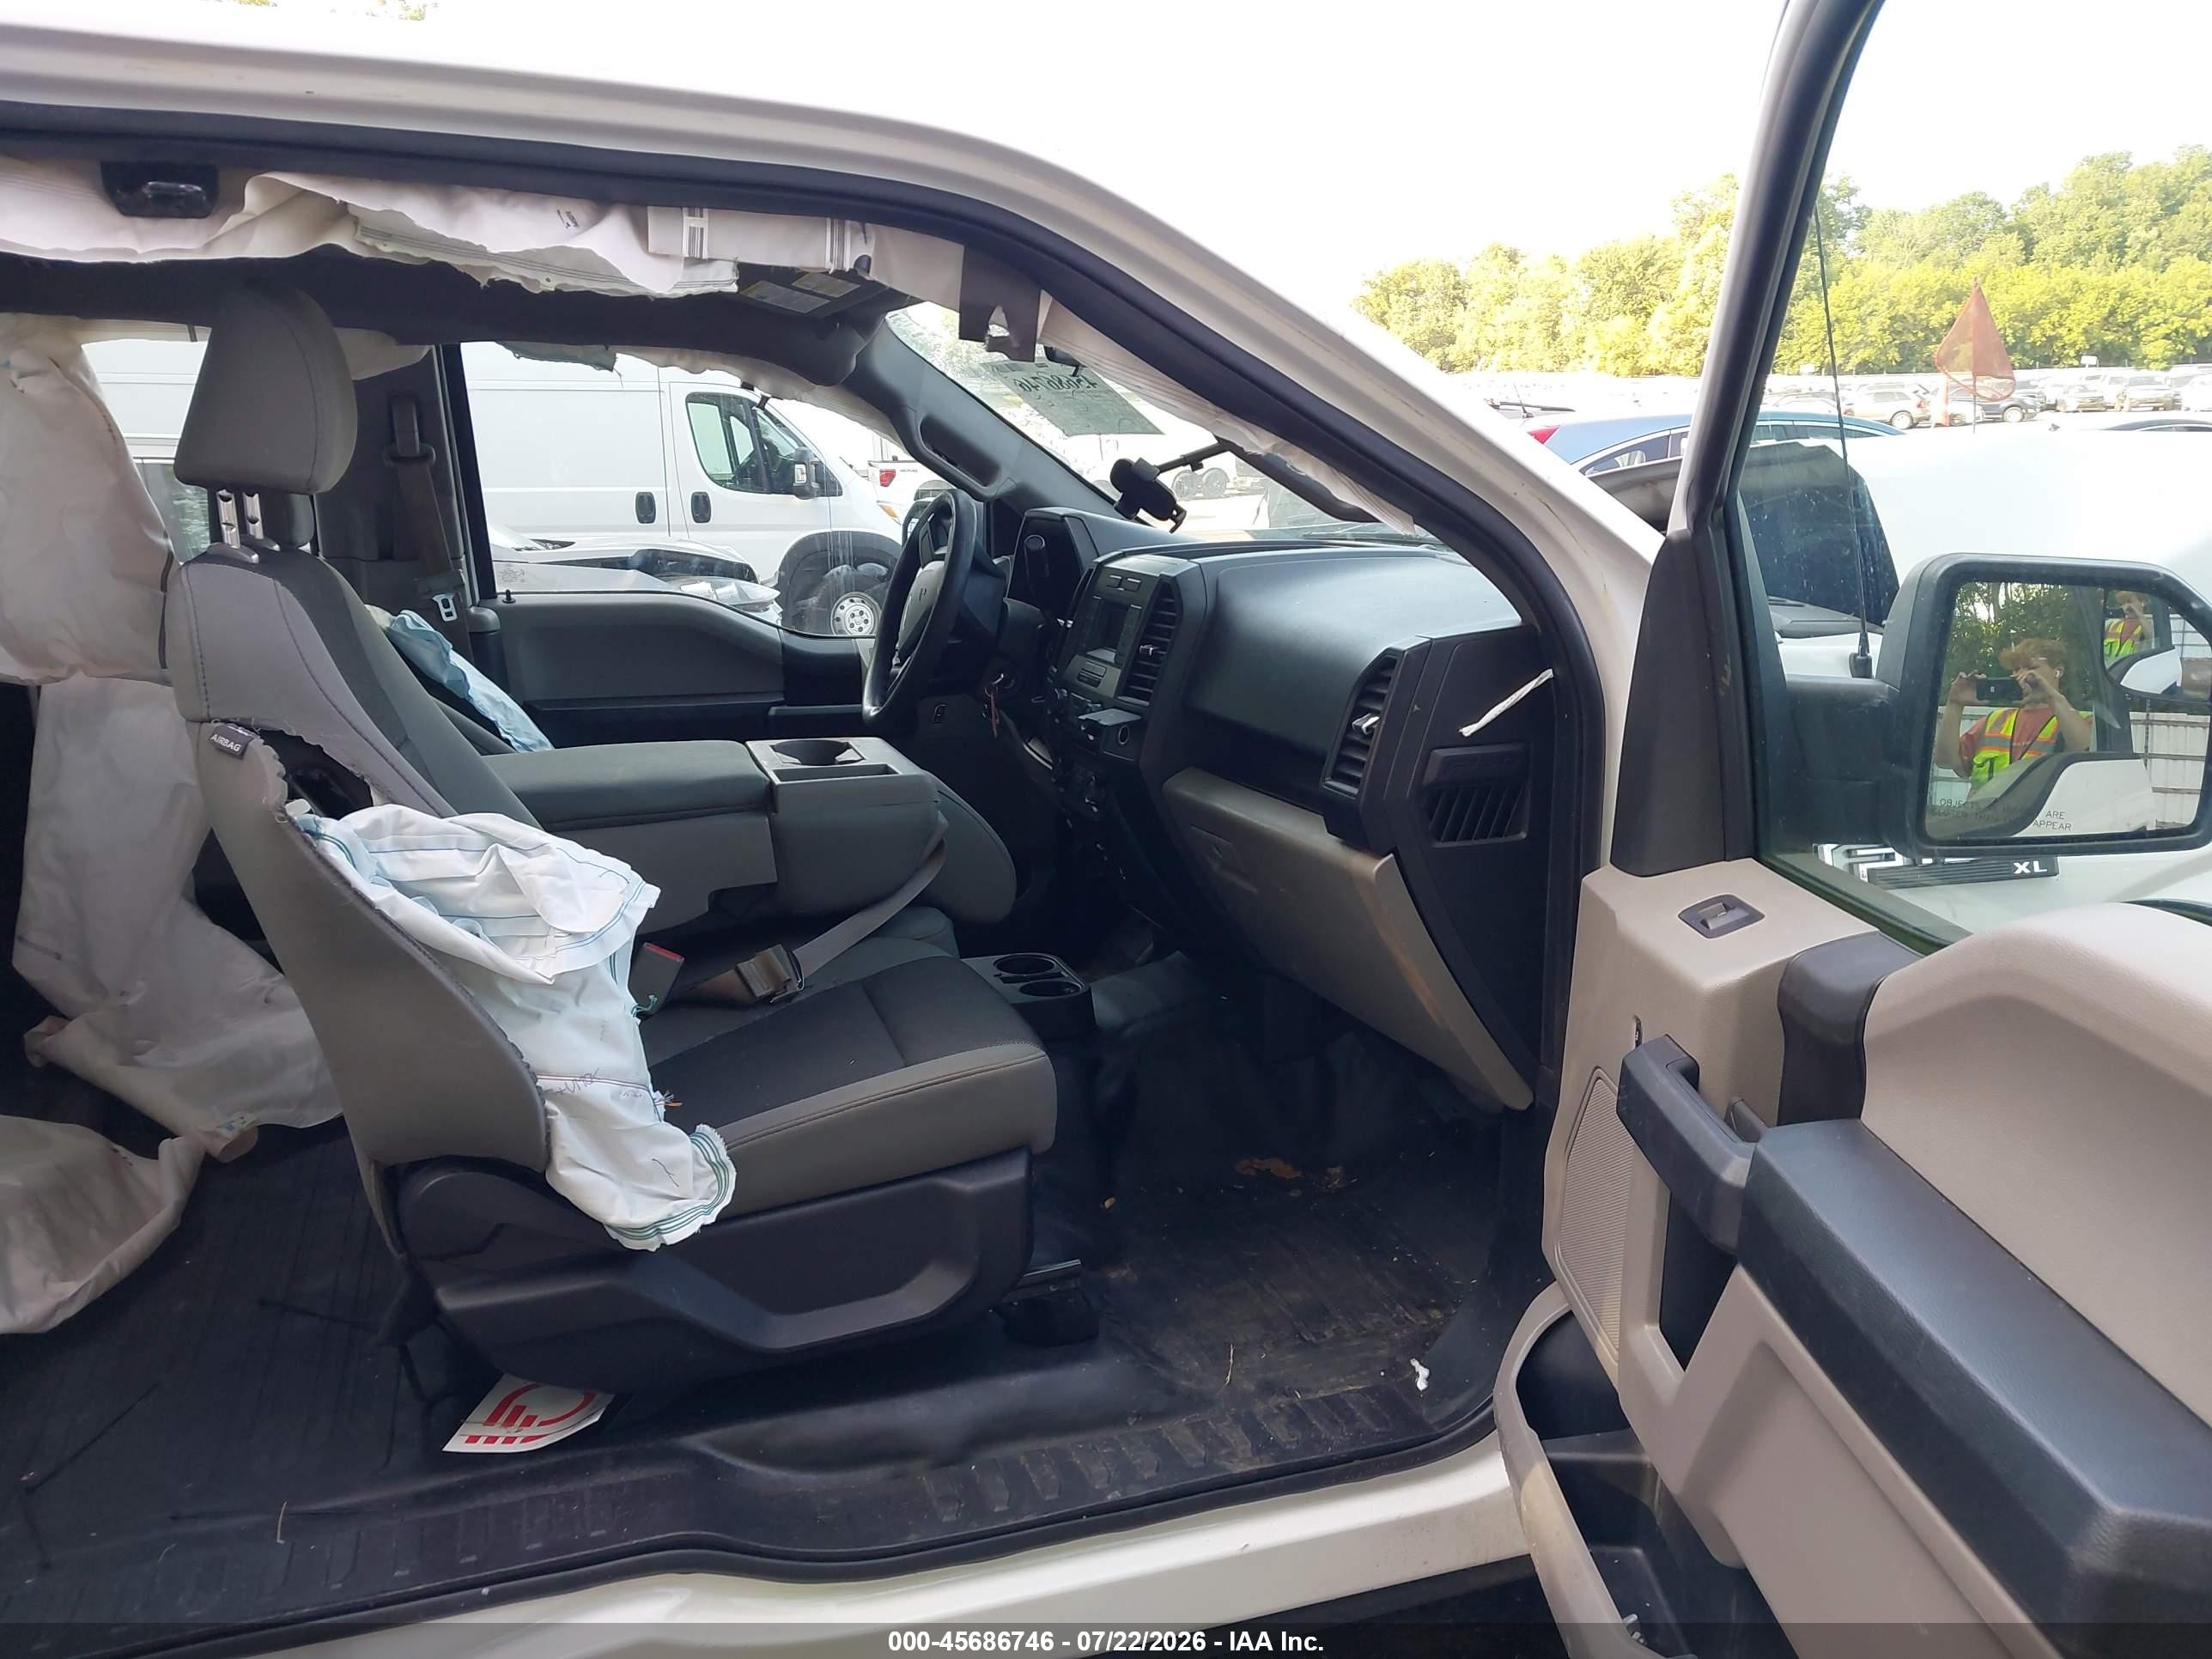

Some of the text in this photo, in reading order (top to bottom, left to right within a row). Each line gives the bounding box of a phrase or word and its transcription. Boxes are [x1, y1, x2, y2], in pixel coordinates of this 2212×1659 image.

[210, 733, 241, 752] AIRBAG
[2045, 810, 2066, 820] ARE
[2033, 819, 2071, 831] APPEAR
[2013, 860, 2048, 874] XL
